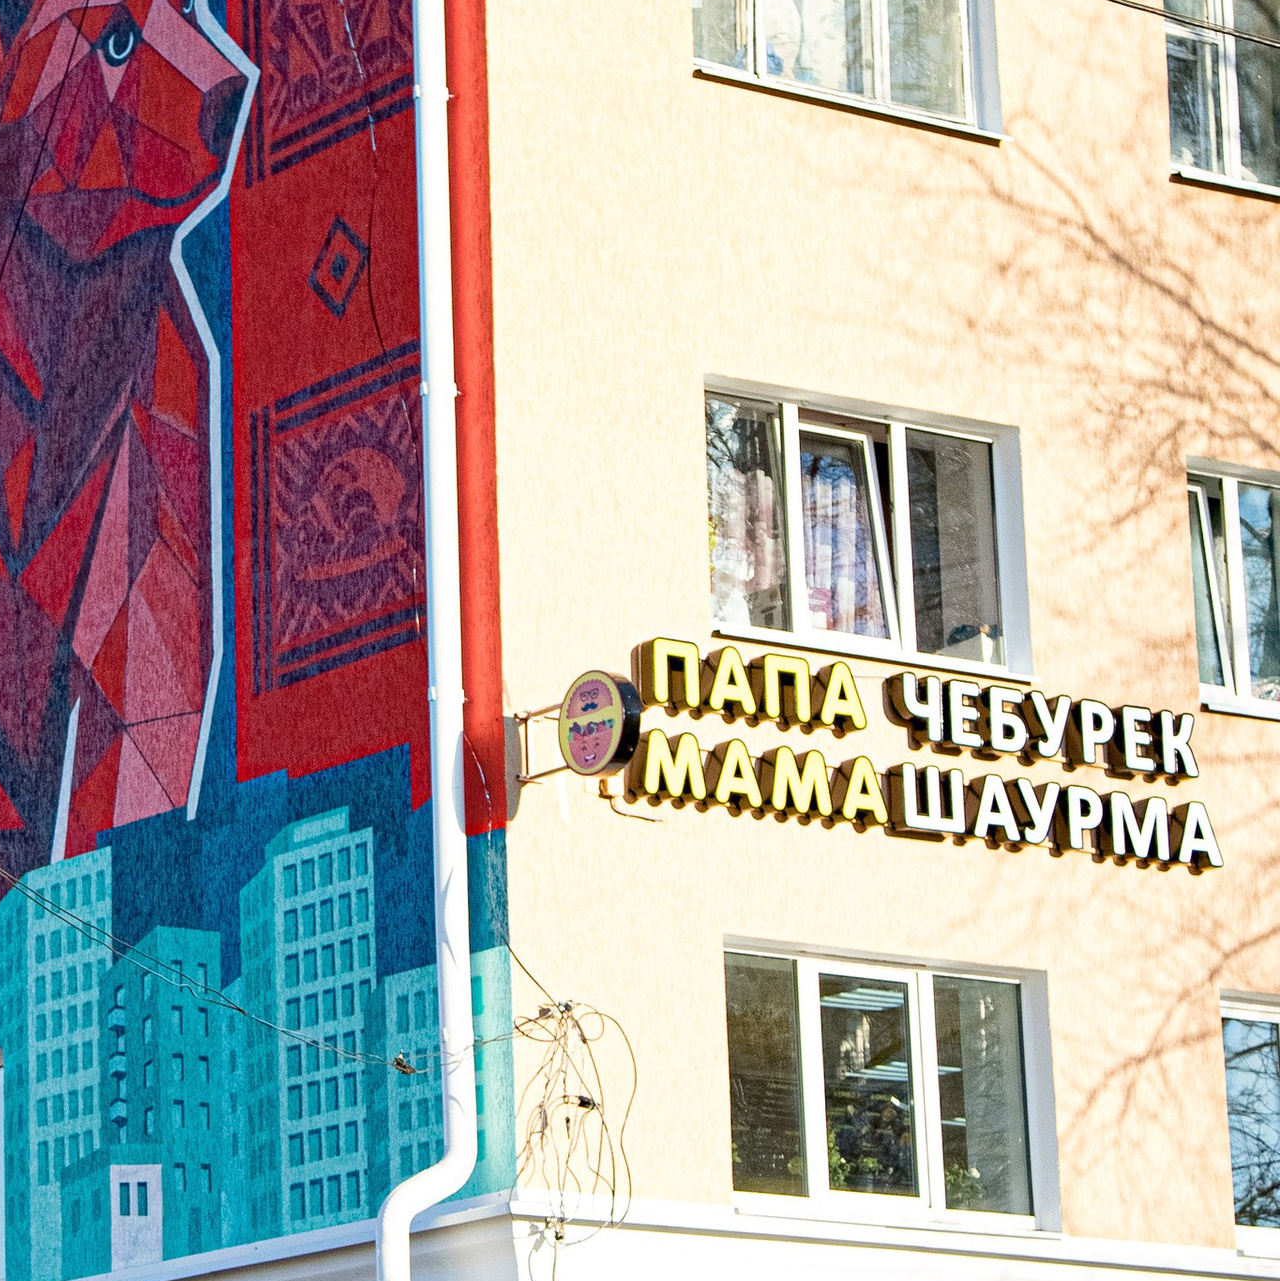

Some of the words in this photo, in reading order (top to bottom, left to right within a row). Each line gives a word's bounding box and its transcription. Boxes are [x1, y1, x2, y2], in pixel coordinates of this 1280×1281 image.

[653, 637, 867, 730] ПАПА
[902, 671, 1200, 778] ЧЕБУРЕК
[644, 728, 888, 824] МАМА
[902, 762, 1224, 868] ШАУРМА
